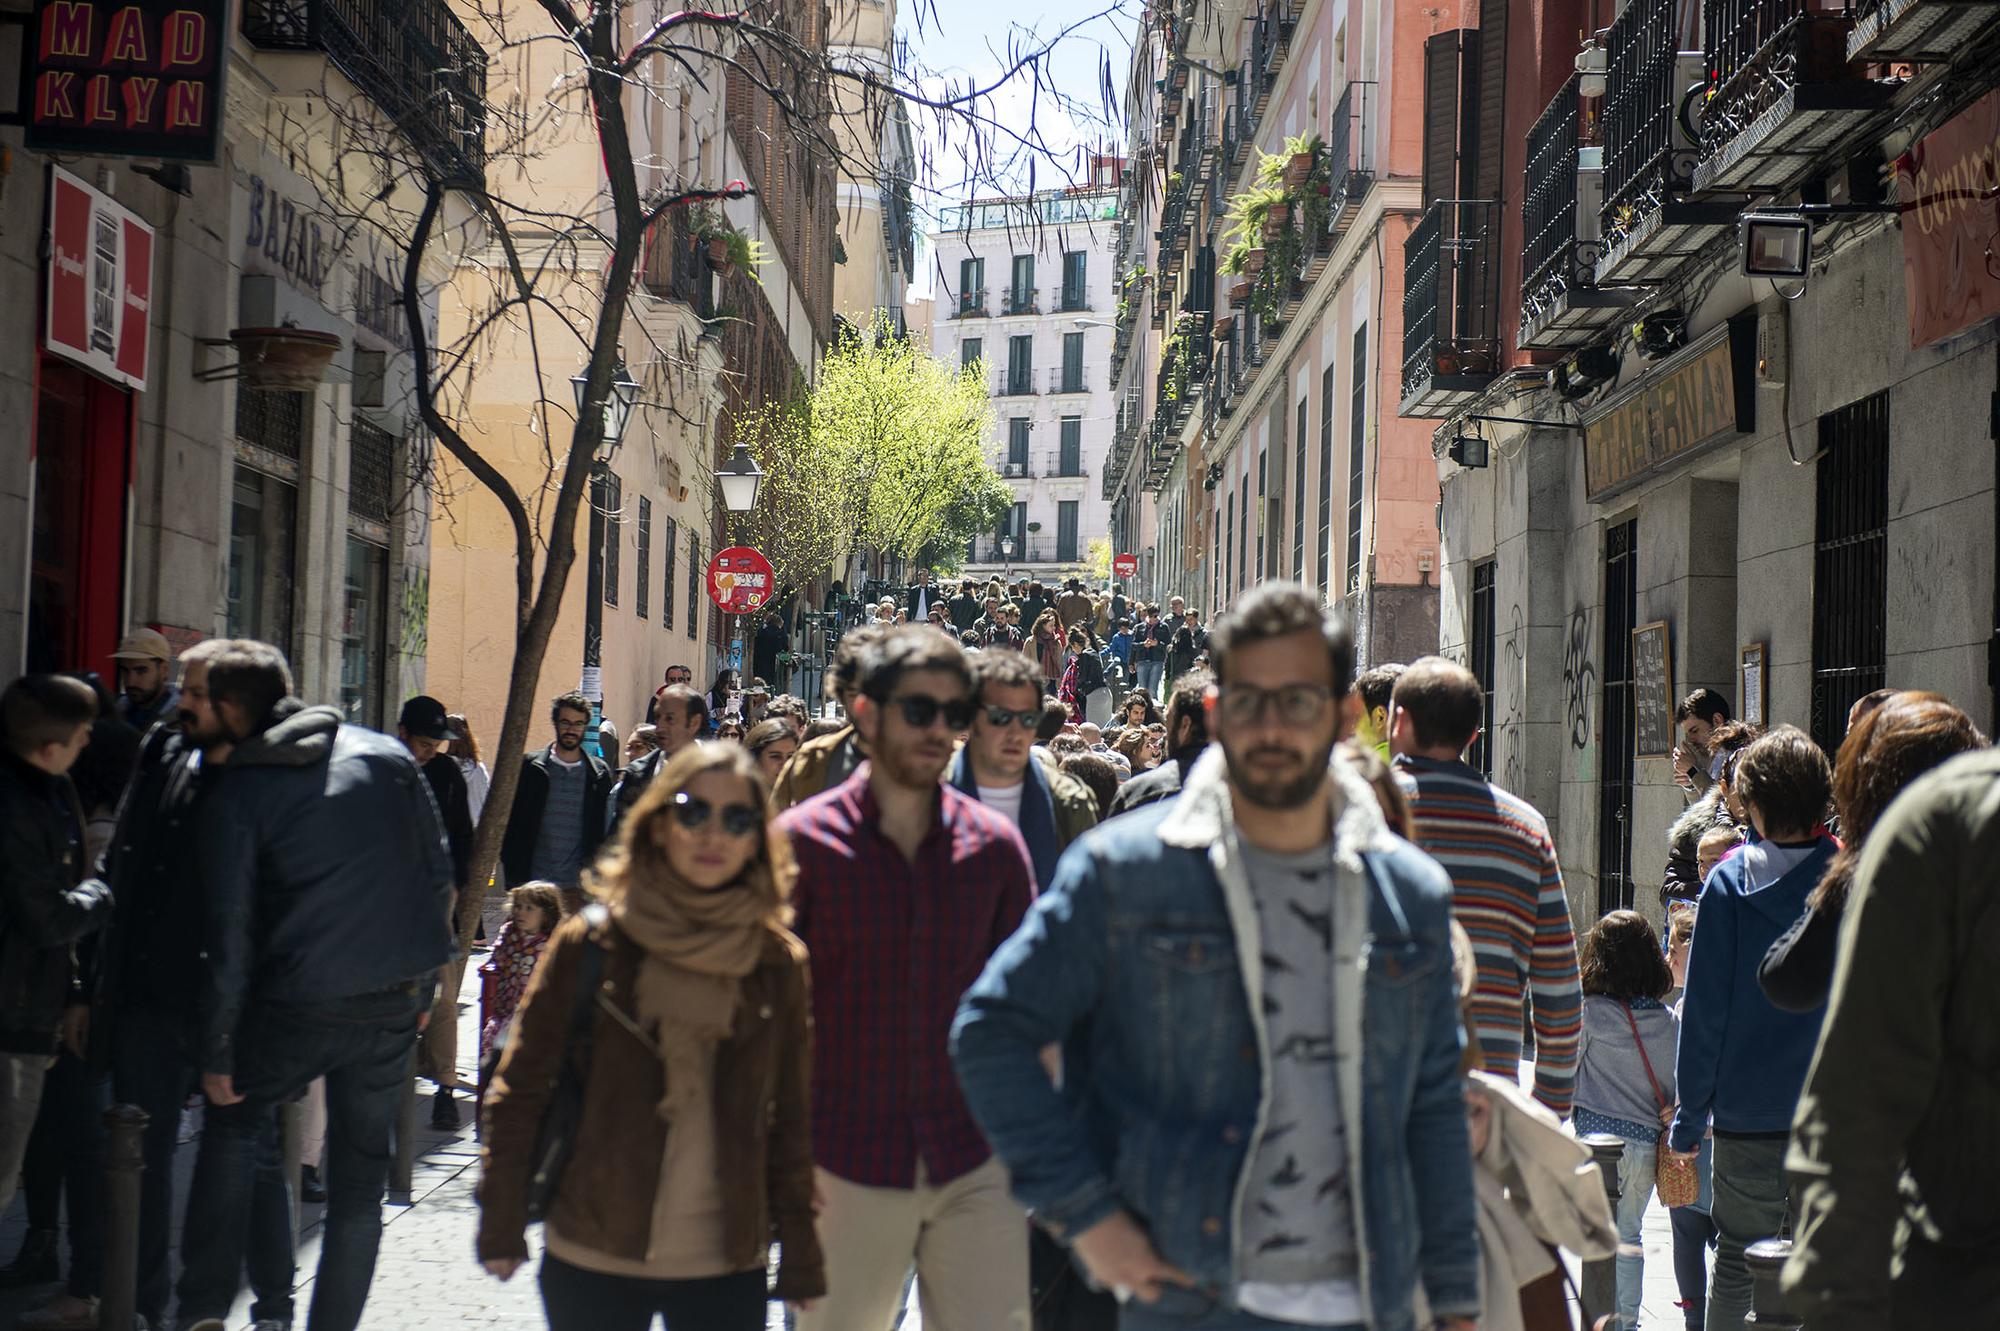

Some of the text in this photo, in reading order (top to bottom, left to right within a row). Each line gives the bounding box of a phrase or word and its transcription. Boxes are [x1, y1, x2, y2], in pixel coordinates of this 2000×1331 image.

[44, 1, 206, 67] MAD
[39, 71, 204, 129] KLYN
[246, 174, 322, 290] BAZAR
